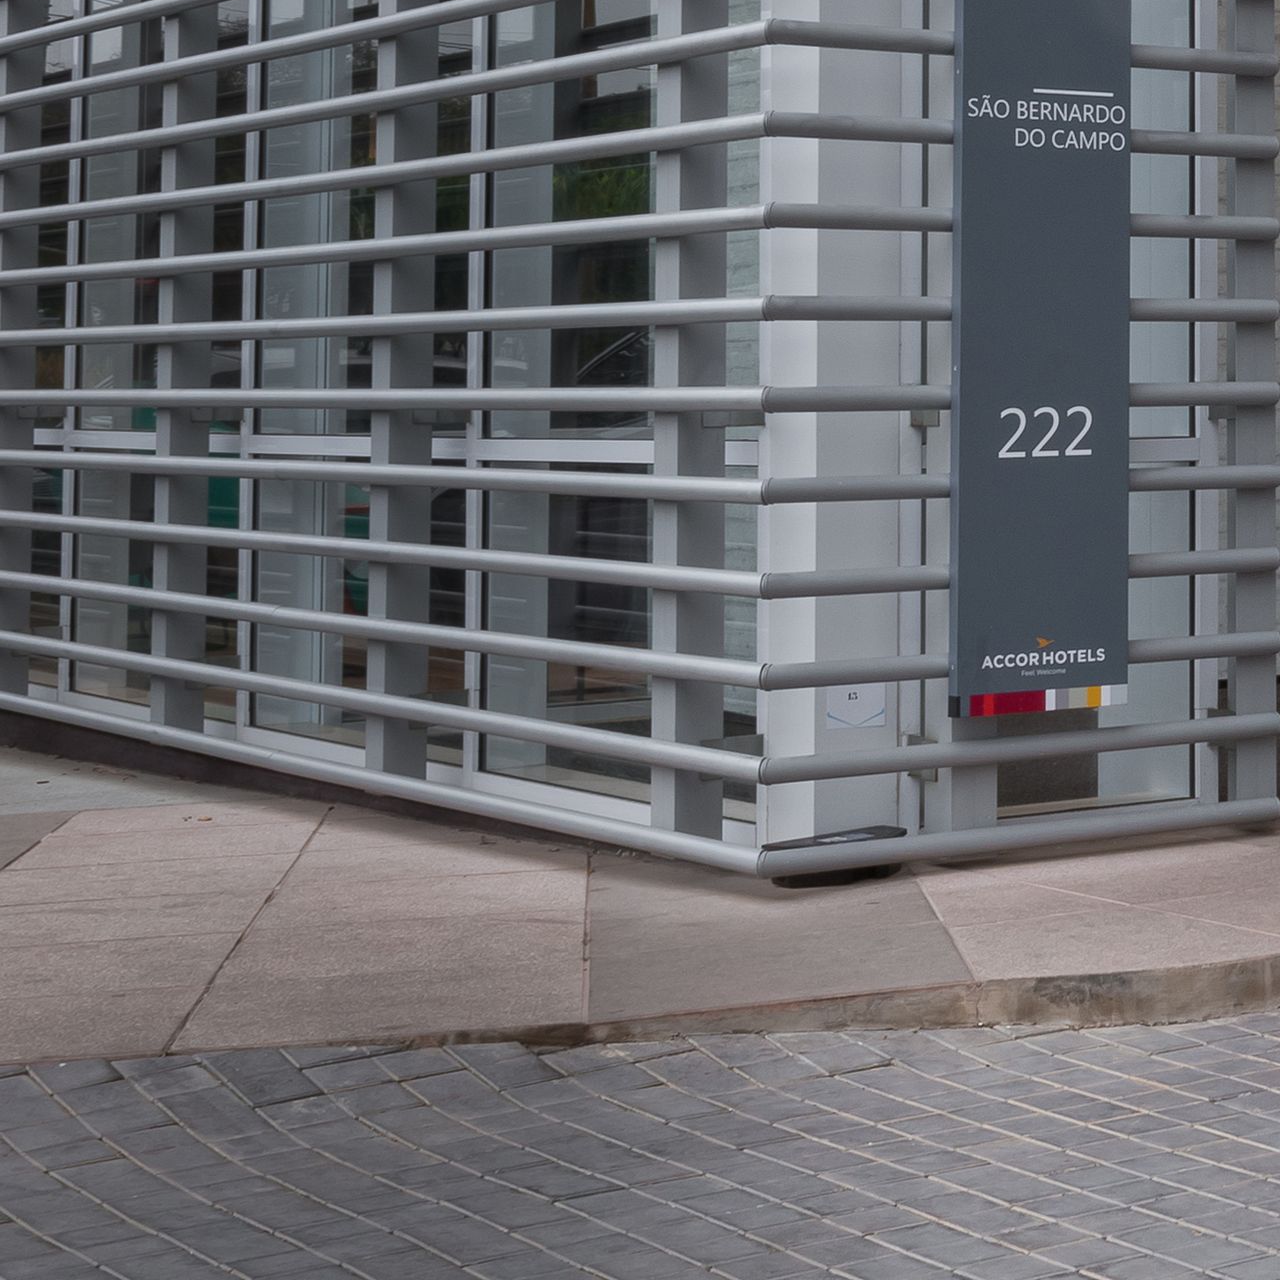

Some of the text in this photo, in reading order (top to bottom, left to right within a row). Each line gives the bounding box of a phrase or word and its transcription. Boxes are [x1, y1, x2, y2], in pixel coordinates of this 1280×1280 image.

[967, 95, 1126, 124] SÃO BERNARDO
[1015, 127, 1126, 151] DO CAMPO
[998, 405, 1093, 458] 222
